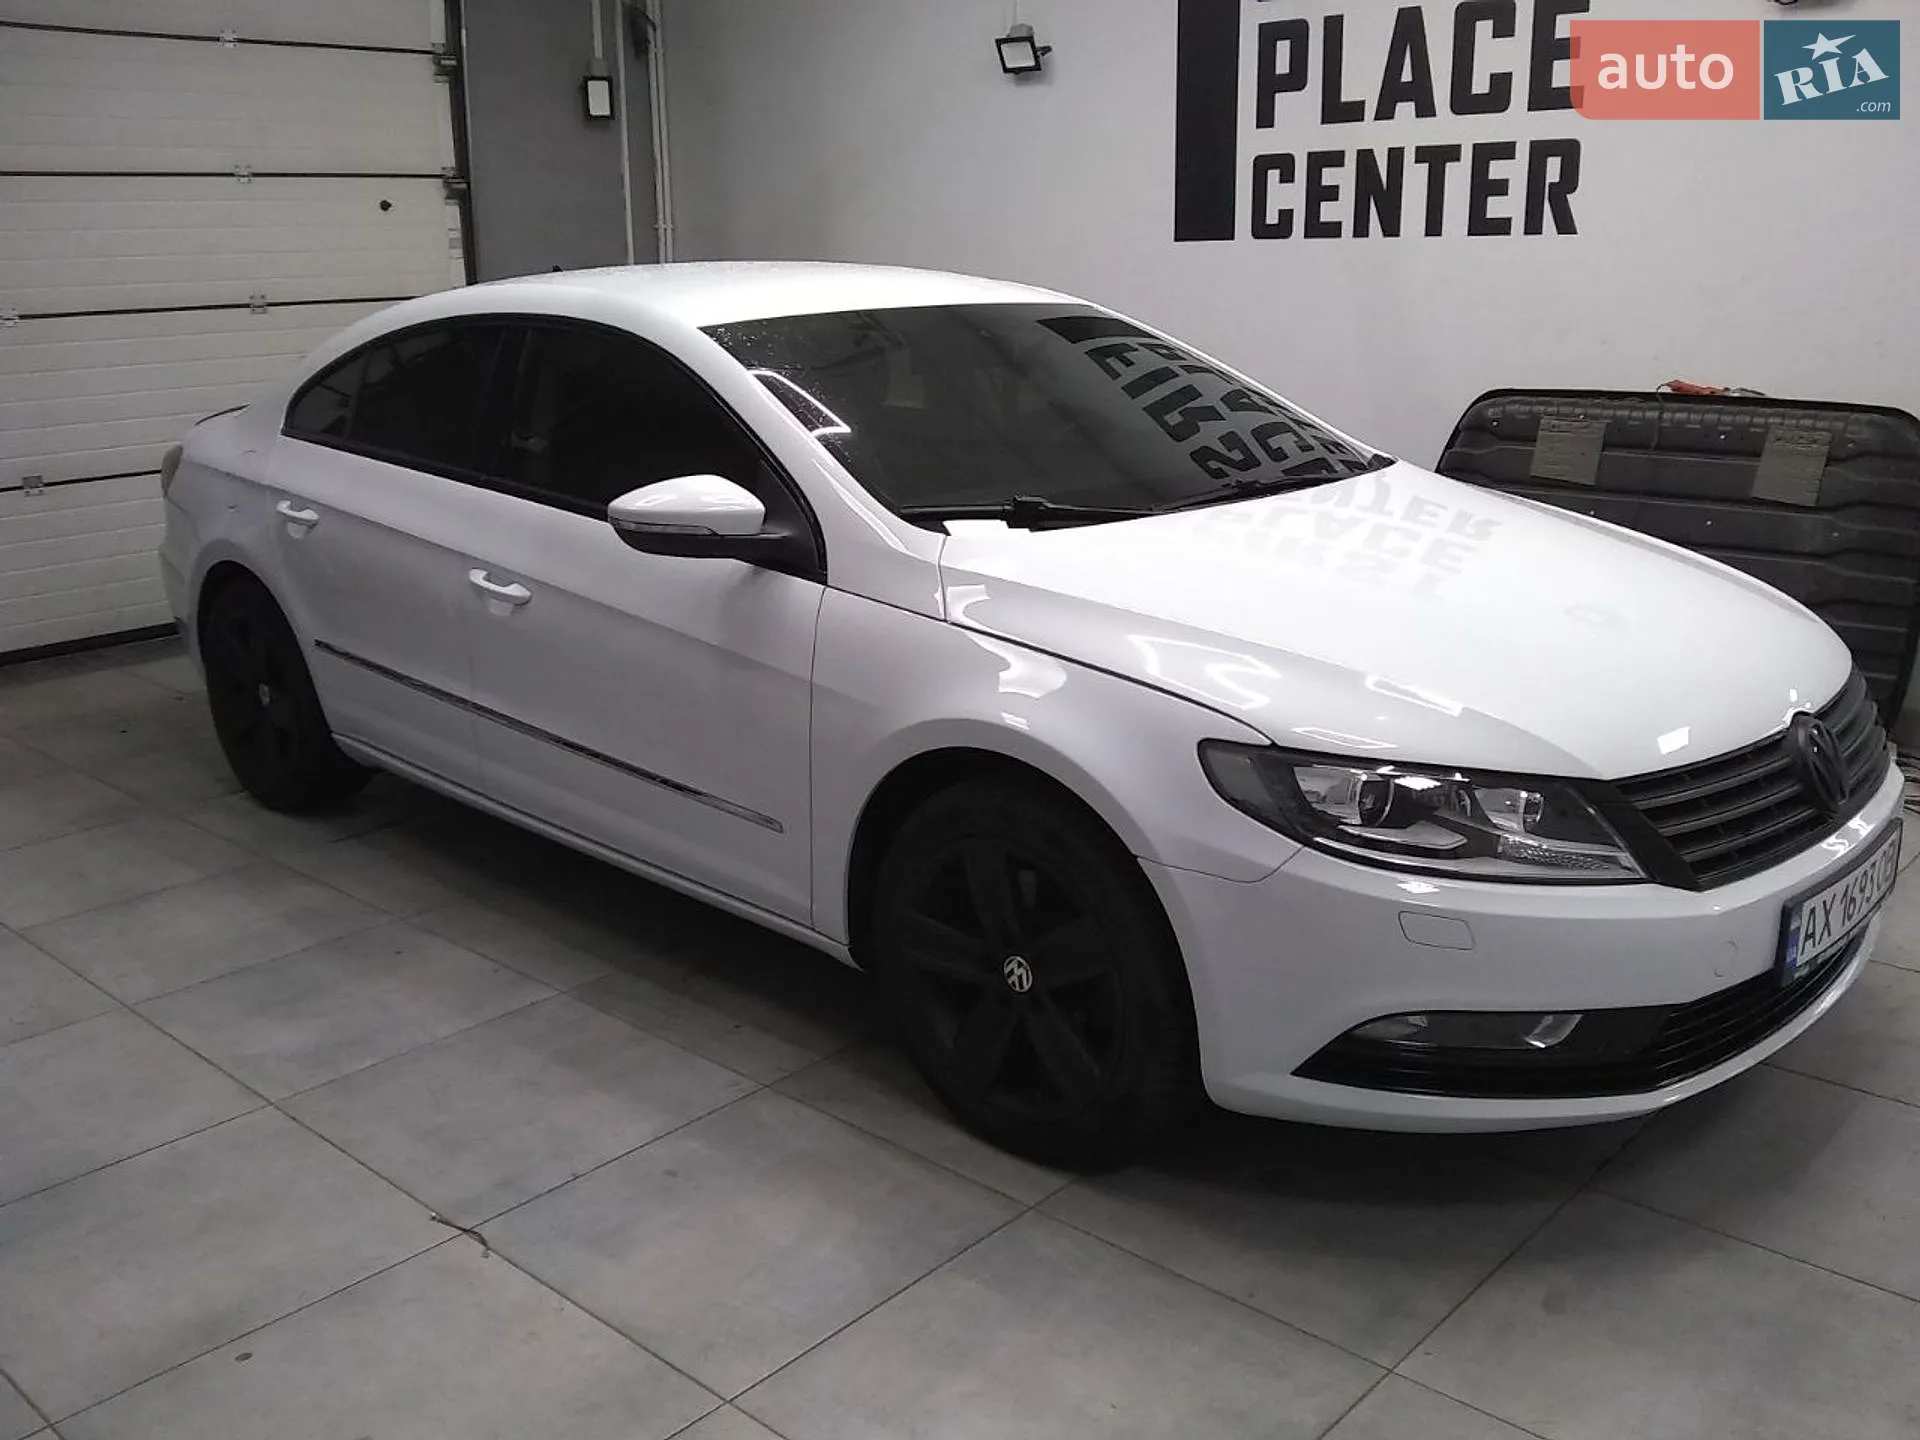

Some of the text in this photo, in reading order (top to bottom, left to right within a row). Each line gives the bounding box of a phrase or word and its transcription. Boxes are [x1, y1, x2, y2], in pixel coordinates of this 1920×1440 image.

[1256, 0, 1590, 129] PLACE
[1251, 138, 1582, 240] CENTER
[1800, 892, 1837, 956] AX
[1840, 859, 1877, 927] 1693
